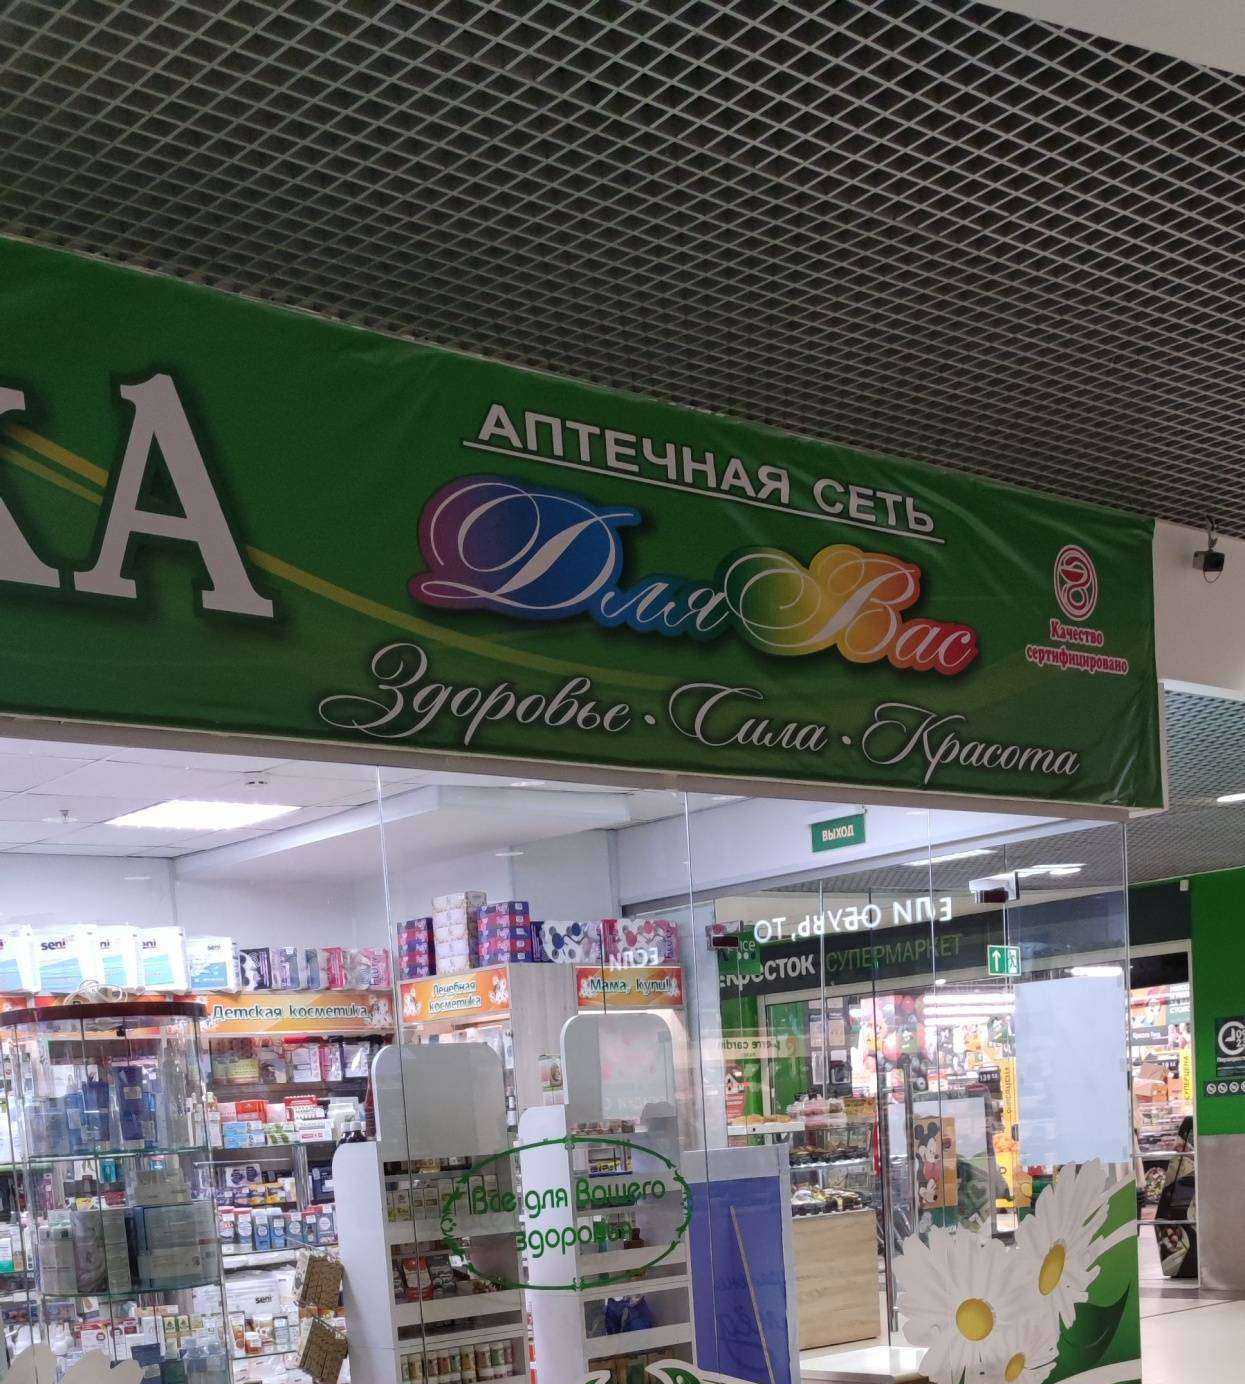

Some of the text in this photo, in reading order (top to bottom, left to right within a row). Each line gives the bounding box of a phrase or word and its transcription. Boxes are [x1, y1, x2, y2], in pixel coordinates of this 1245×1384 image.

[478, 403, 935, 533] АПТЕЧНАЯ СЕТЬ
[420, 482, 977, 665] Для Вас
[1051, 619, 1104, 646] Качество
[1026, 645, 1128, 674] сертифицировано
[319, 643, 1080, 784] Здоровье Сила Красота
[822, 825, 854, 843] ВЫХОД
[41, 939, 67, 951] seni
[826, 933, 963, 973] СУПЕРМАРКЕТ
[433, 980, 477, 997] Лечебная
[213, 1003, 368, 1021] Детская косметика
[429, 994, 482, 1013] косметика
[472, 1177, 666, 1219] Все для Вашего
[516, 1220, 633, 1259] здоровья
[256, 1296, 273, 1305] seni
